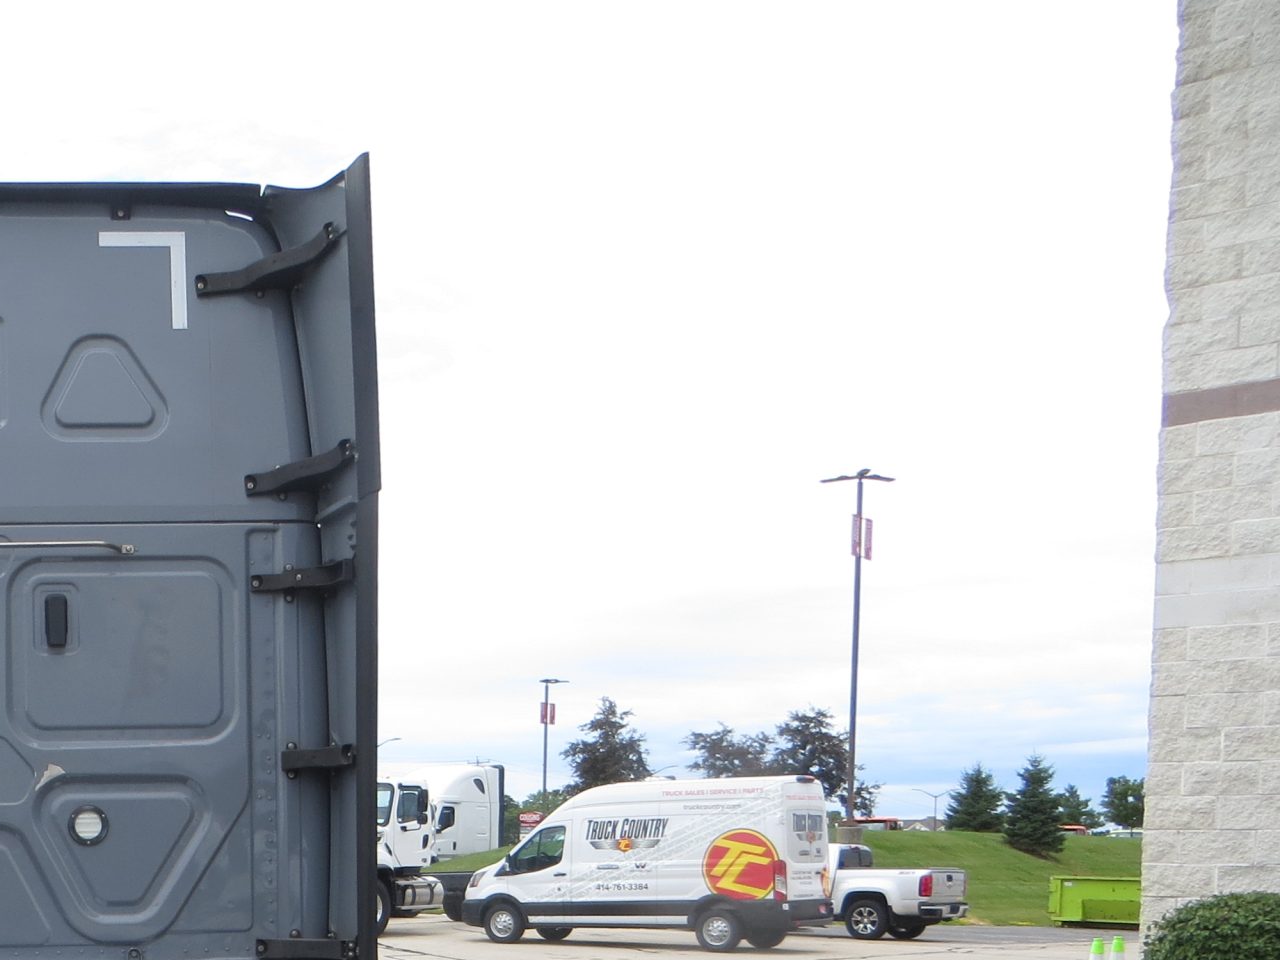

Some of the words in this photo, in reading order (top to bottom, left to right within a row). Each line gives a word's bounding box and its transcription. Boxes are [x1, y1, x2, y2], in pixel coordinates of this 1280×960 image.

[586, 819, 619, 840] TRUCK
[620, 818, 669, 839] COUNTRY
[710, 838, 774, 900] TC
